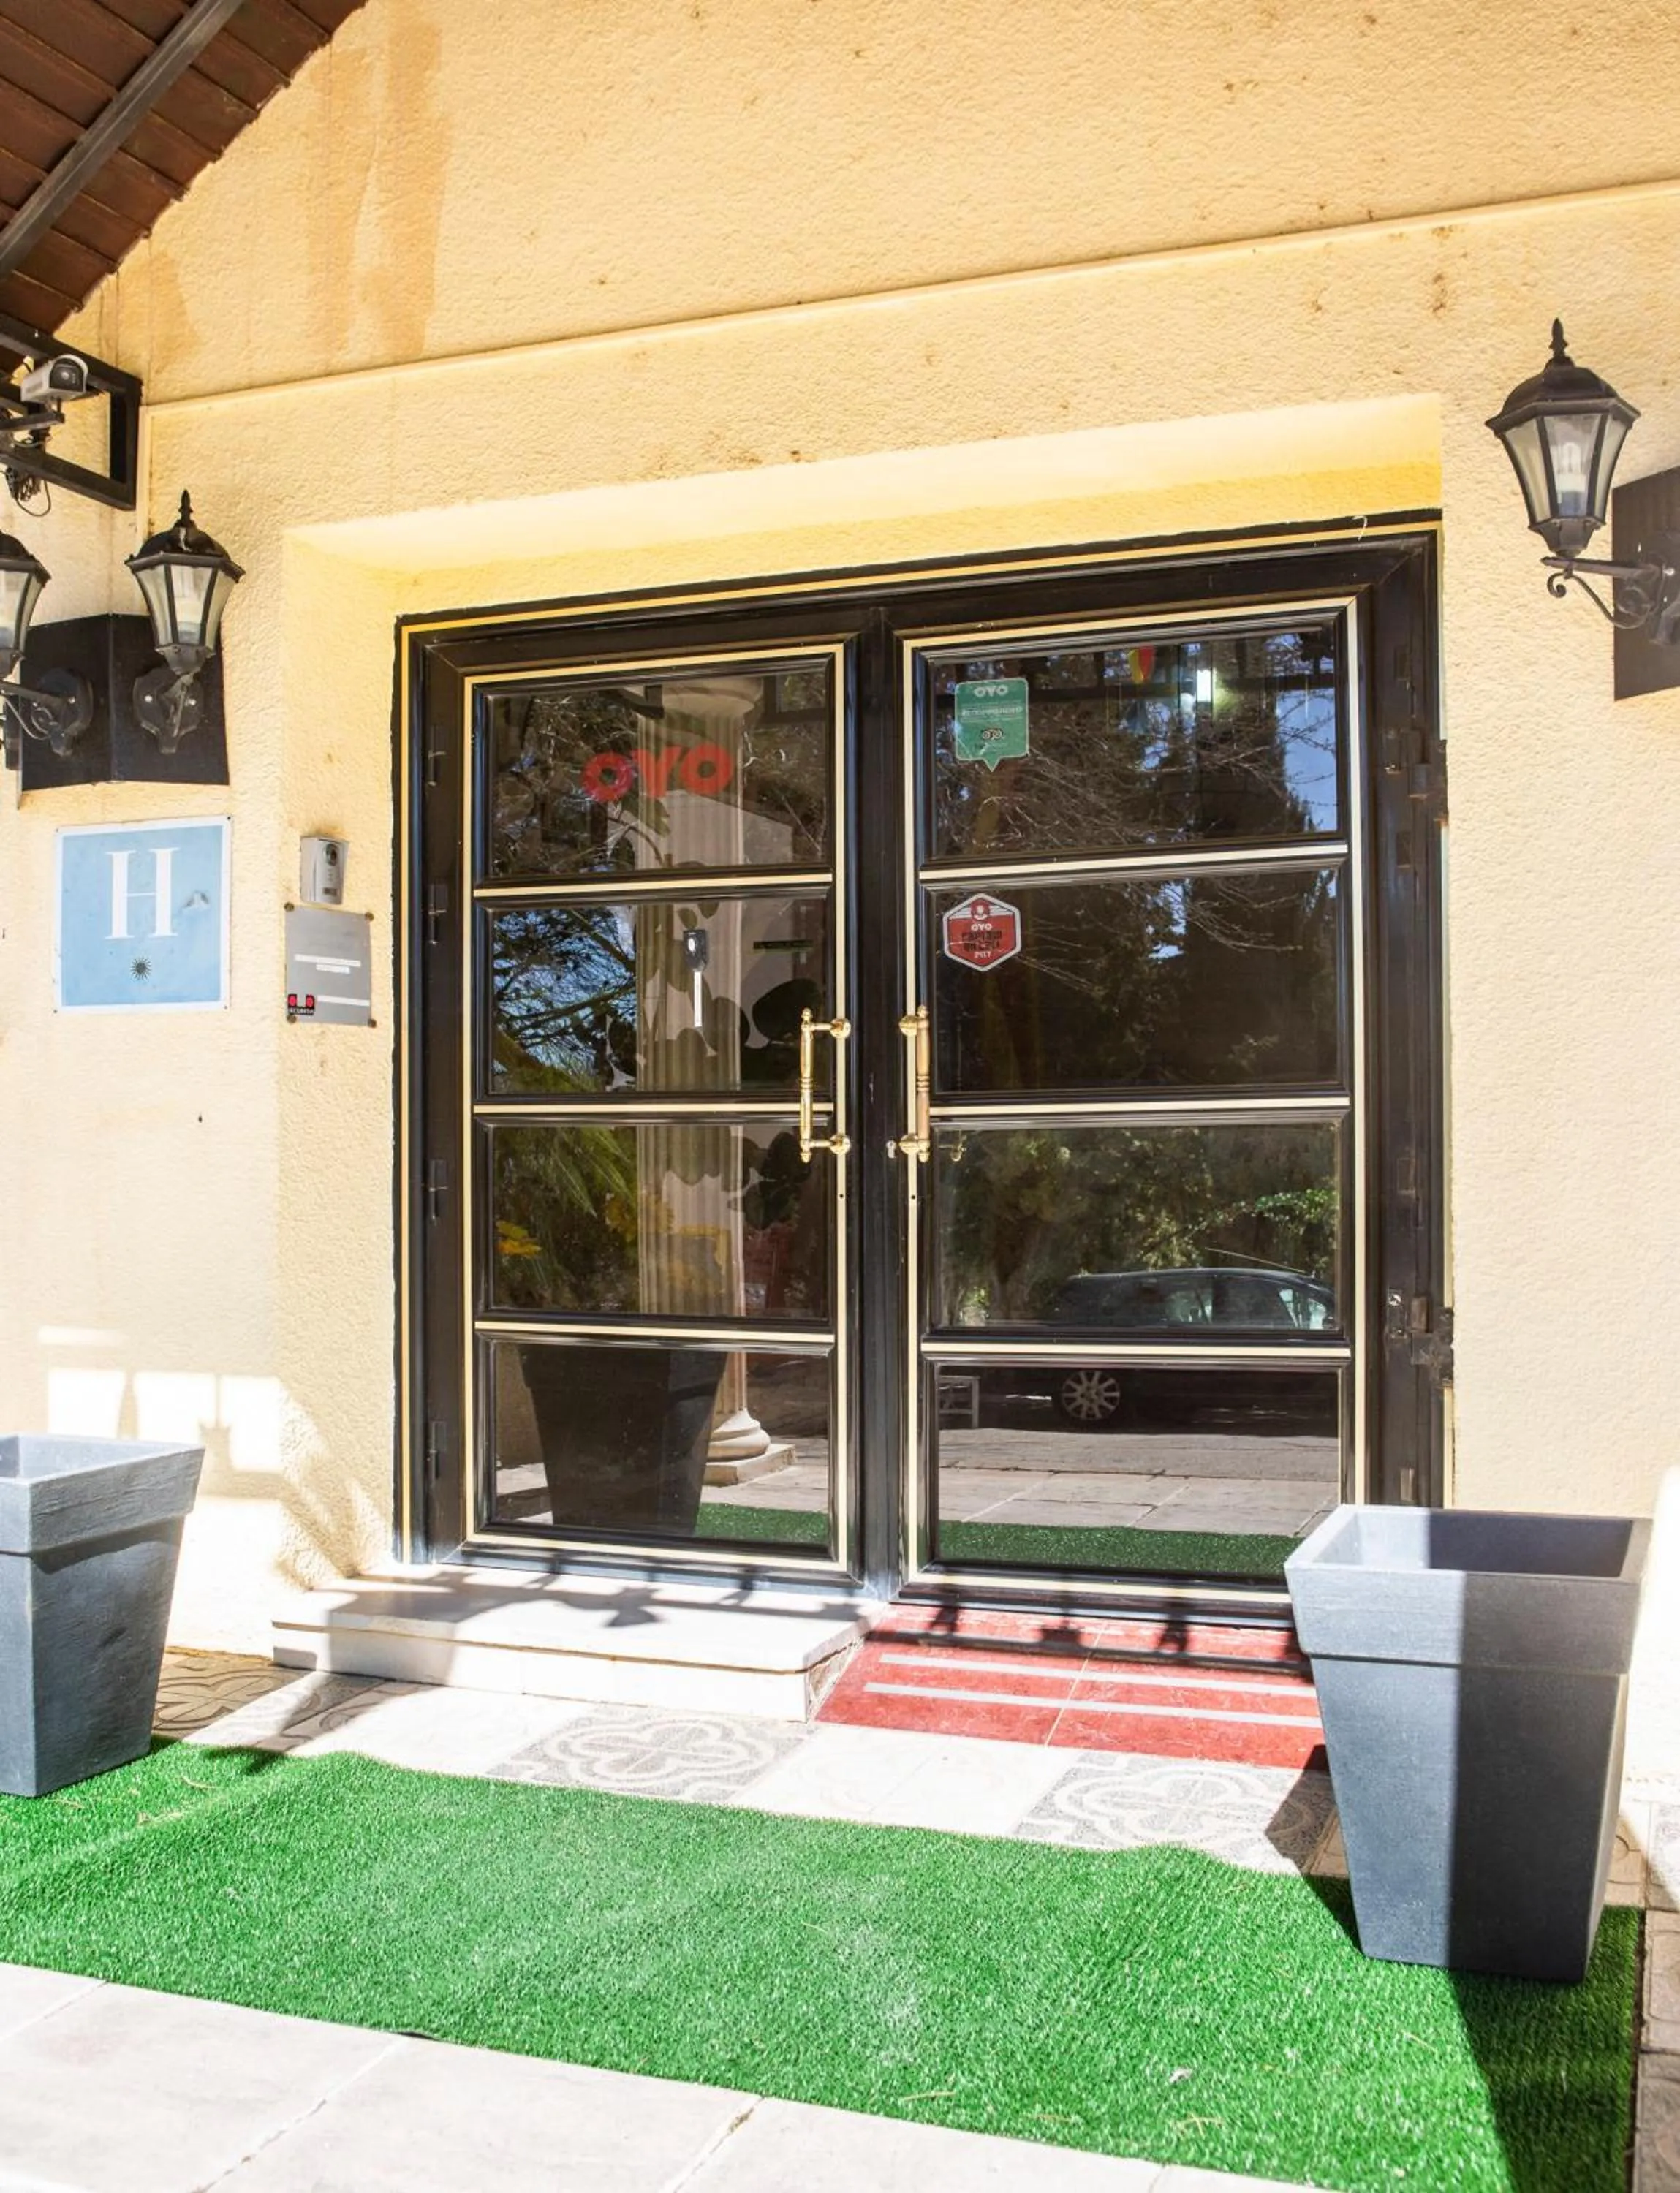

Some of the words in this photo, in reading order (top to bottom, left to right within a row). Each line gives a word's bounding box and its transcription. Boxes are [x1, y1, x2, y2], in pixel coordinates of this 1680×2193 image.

[974, 684, 1008, 698] OYO
[580, 742, 733, 802] OYO
[105, 847, 181, 939] H
[971, 923, 992, 931] OYO
